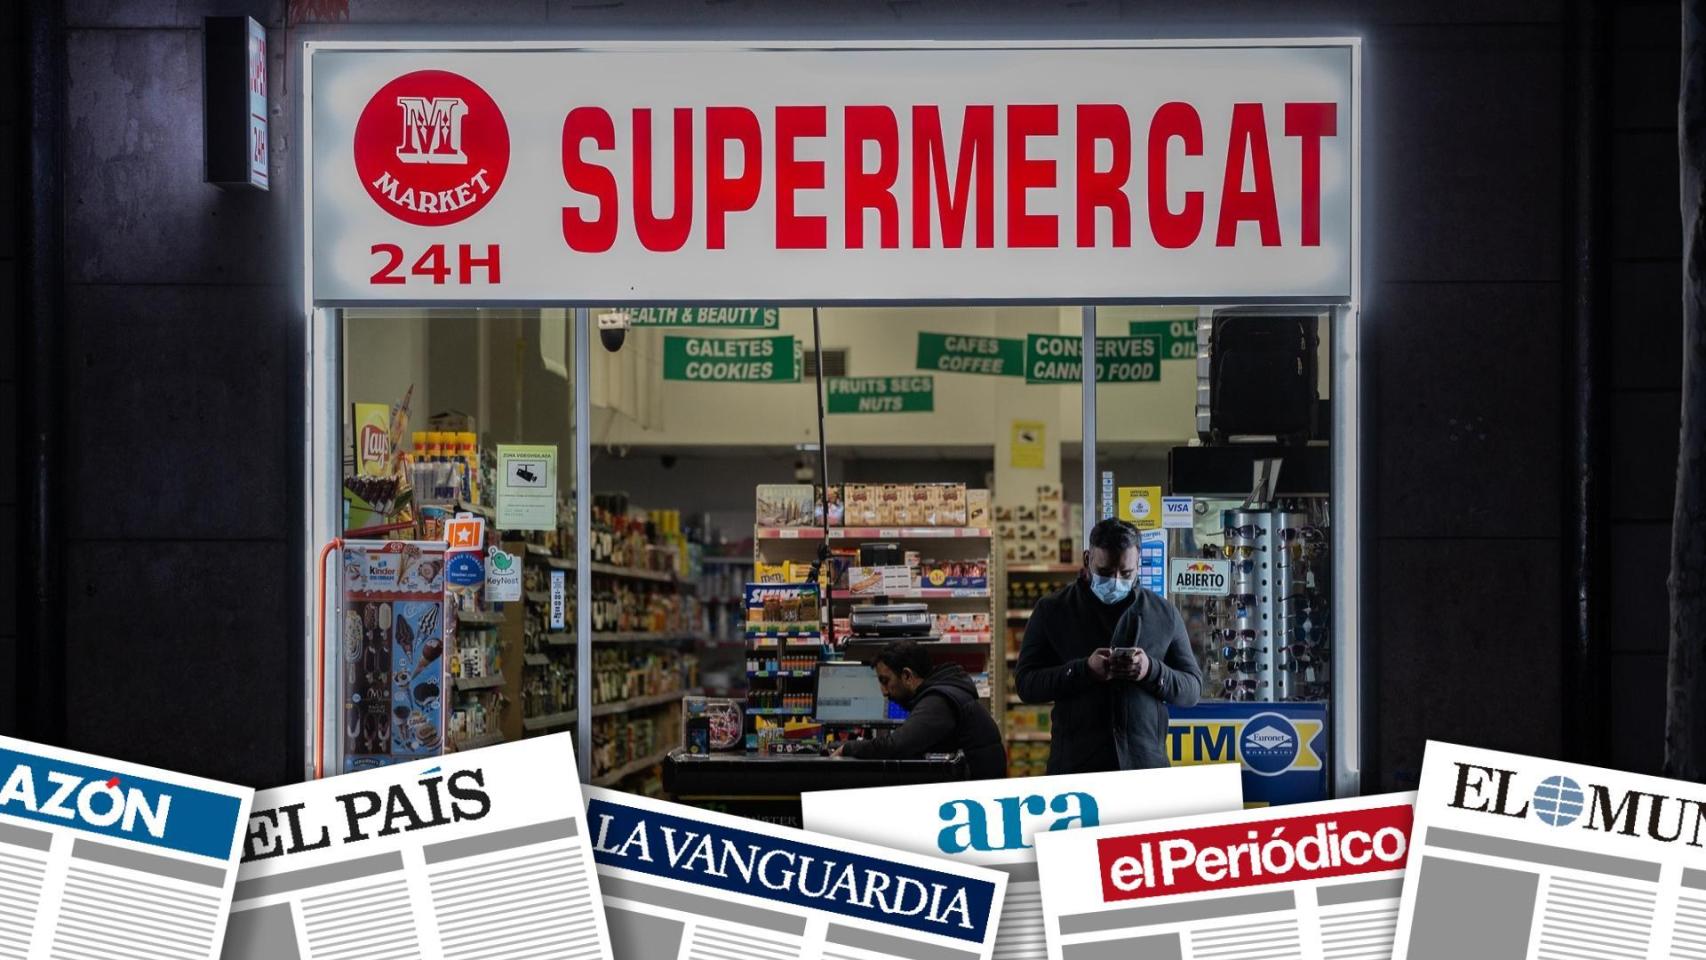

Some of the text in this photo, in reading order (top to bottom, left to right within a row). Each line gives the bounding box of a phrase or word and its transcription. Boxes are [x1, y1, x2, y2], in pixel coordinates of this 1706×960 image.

[397, 97, 468, 164] M
[562, 101, 1337, 252] SUPERMERCAT
[372, 169, 490, 213] MARKET
[370, 244, 501, 284] 24H
[682, 308, 692, 323] &
[698, 308, 758, 323] BEAUTY
[686, 339, 773, 357] GALETES
[944, 336, 999, 353] CAFES
[1035, 337, 1154, 357] CONERVES
[686, 362, 773, 379] COOKIES
[937, 355, 1004, 374] COFFEE
[1033, 361, 1154, 380] CANND FOOD
[829, 377, 932, 395] FRUITS SECS
[858, 397, 902, 412] NUTS
[1167, 503, 1189, 513] VISA
[487, 577, 518, 585] KeyNest
[1176, 573, 1225, 587] ABIERTO
[1168, 726, 1236, 761] TM
[1253, 734, 1285, 742] Euronet
